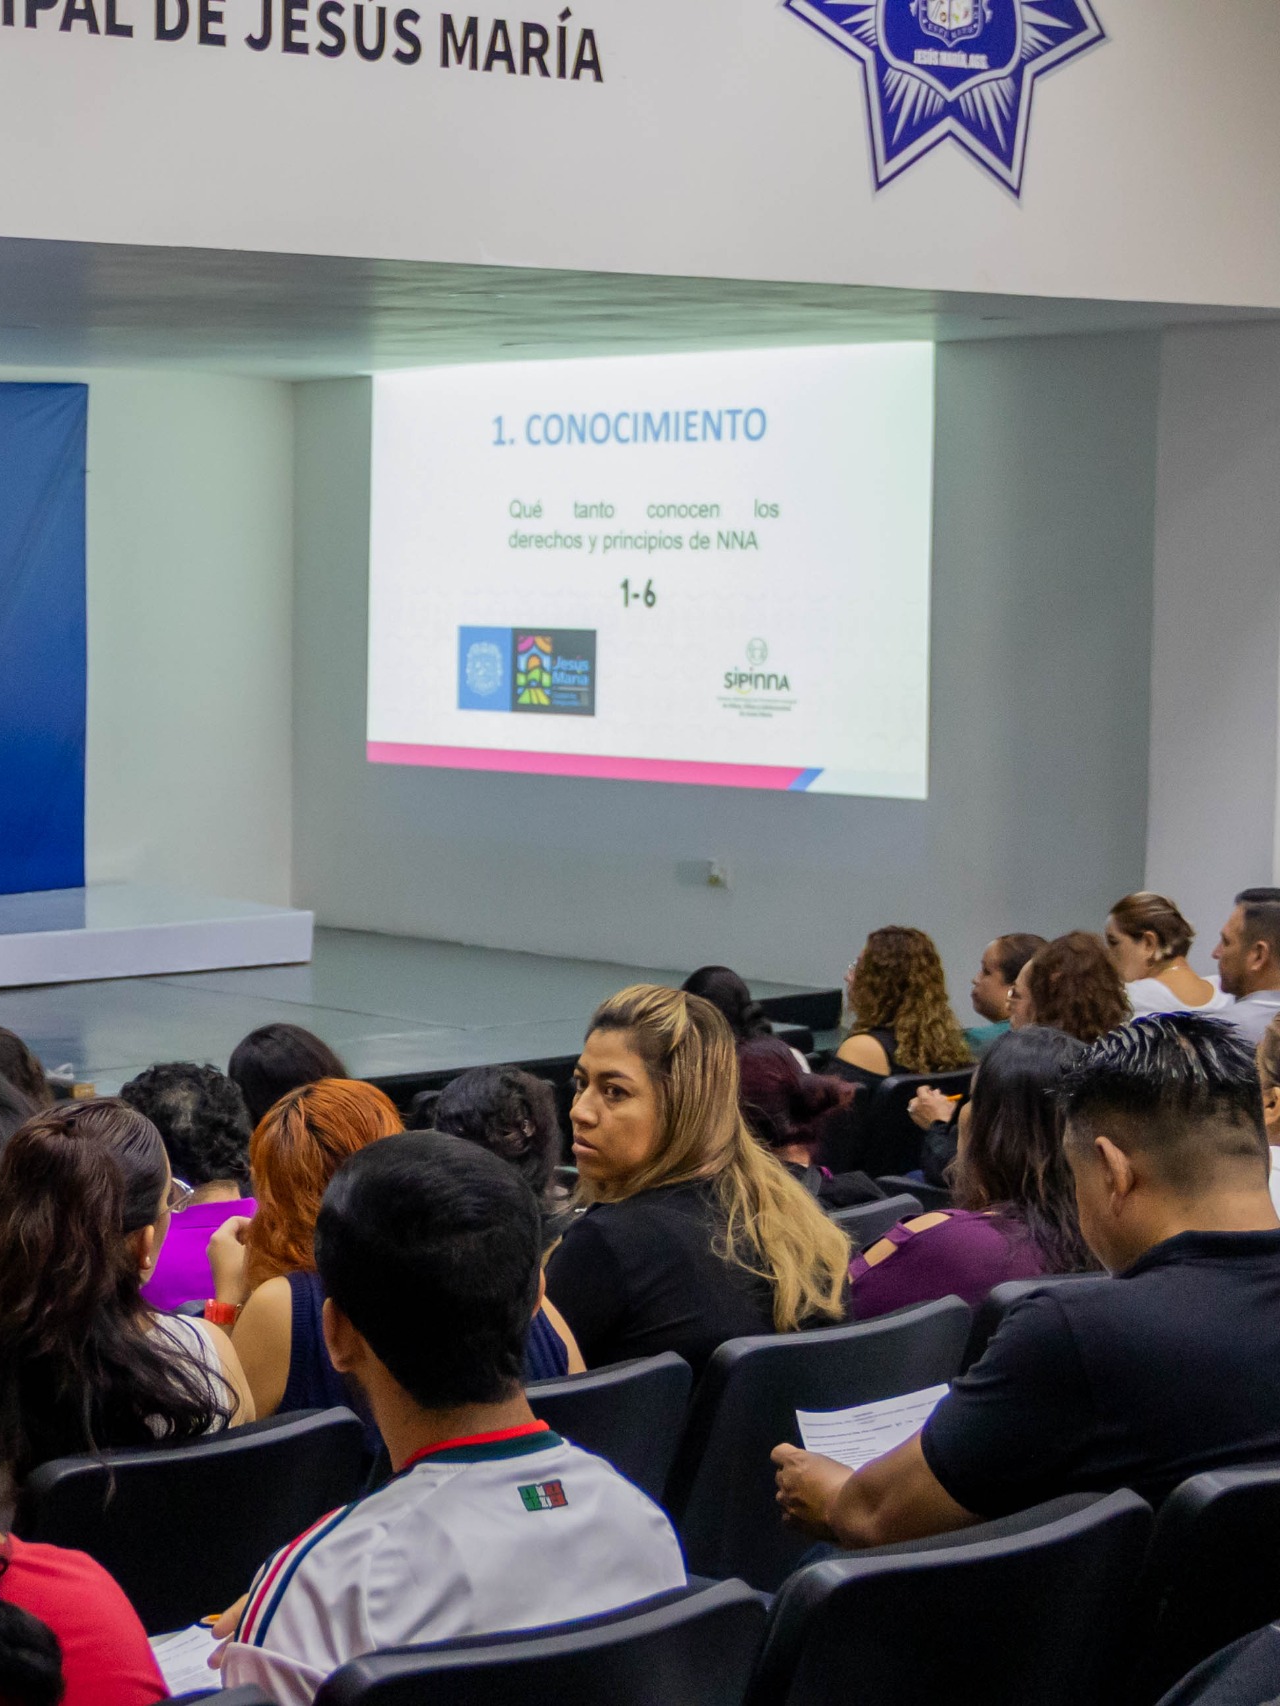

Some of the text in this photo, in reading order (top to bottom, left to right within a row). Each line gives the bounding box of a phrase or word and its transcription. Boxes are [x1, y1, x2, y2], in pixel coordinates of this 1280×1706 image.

[154, 0, 227, 47] DE
[244, 0, 421, 66] JESÚS
[439, 7, 604, 83] MARÍA
[492, 407, 768, 446] 1. CONOCIMIENTO
[508, 499, 780, 520] Qué tanto conocen los
[508, 530, 759, 555] derechos y principios de NNA
